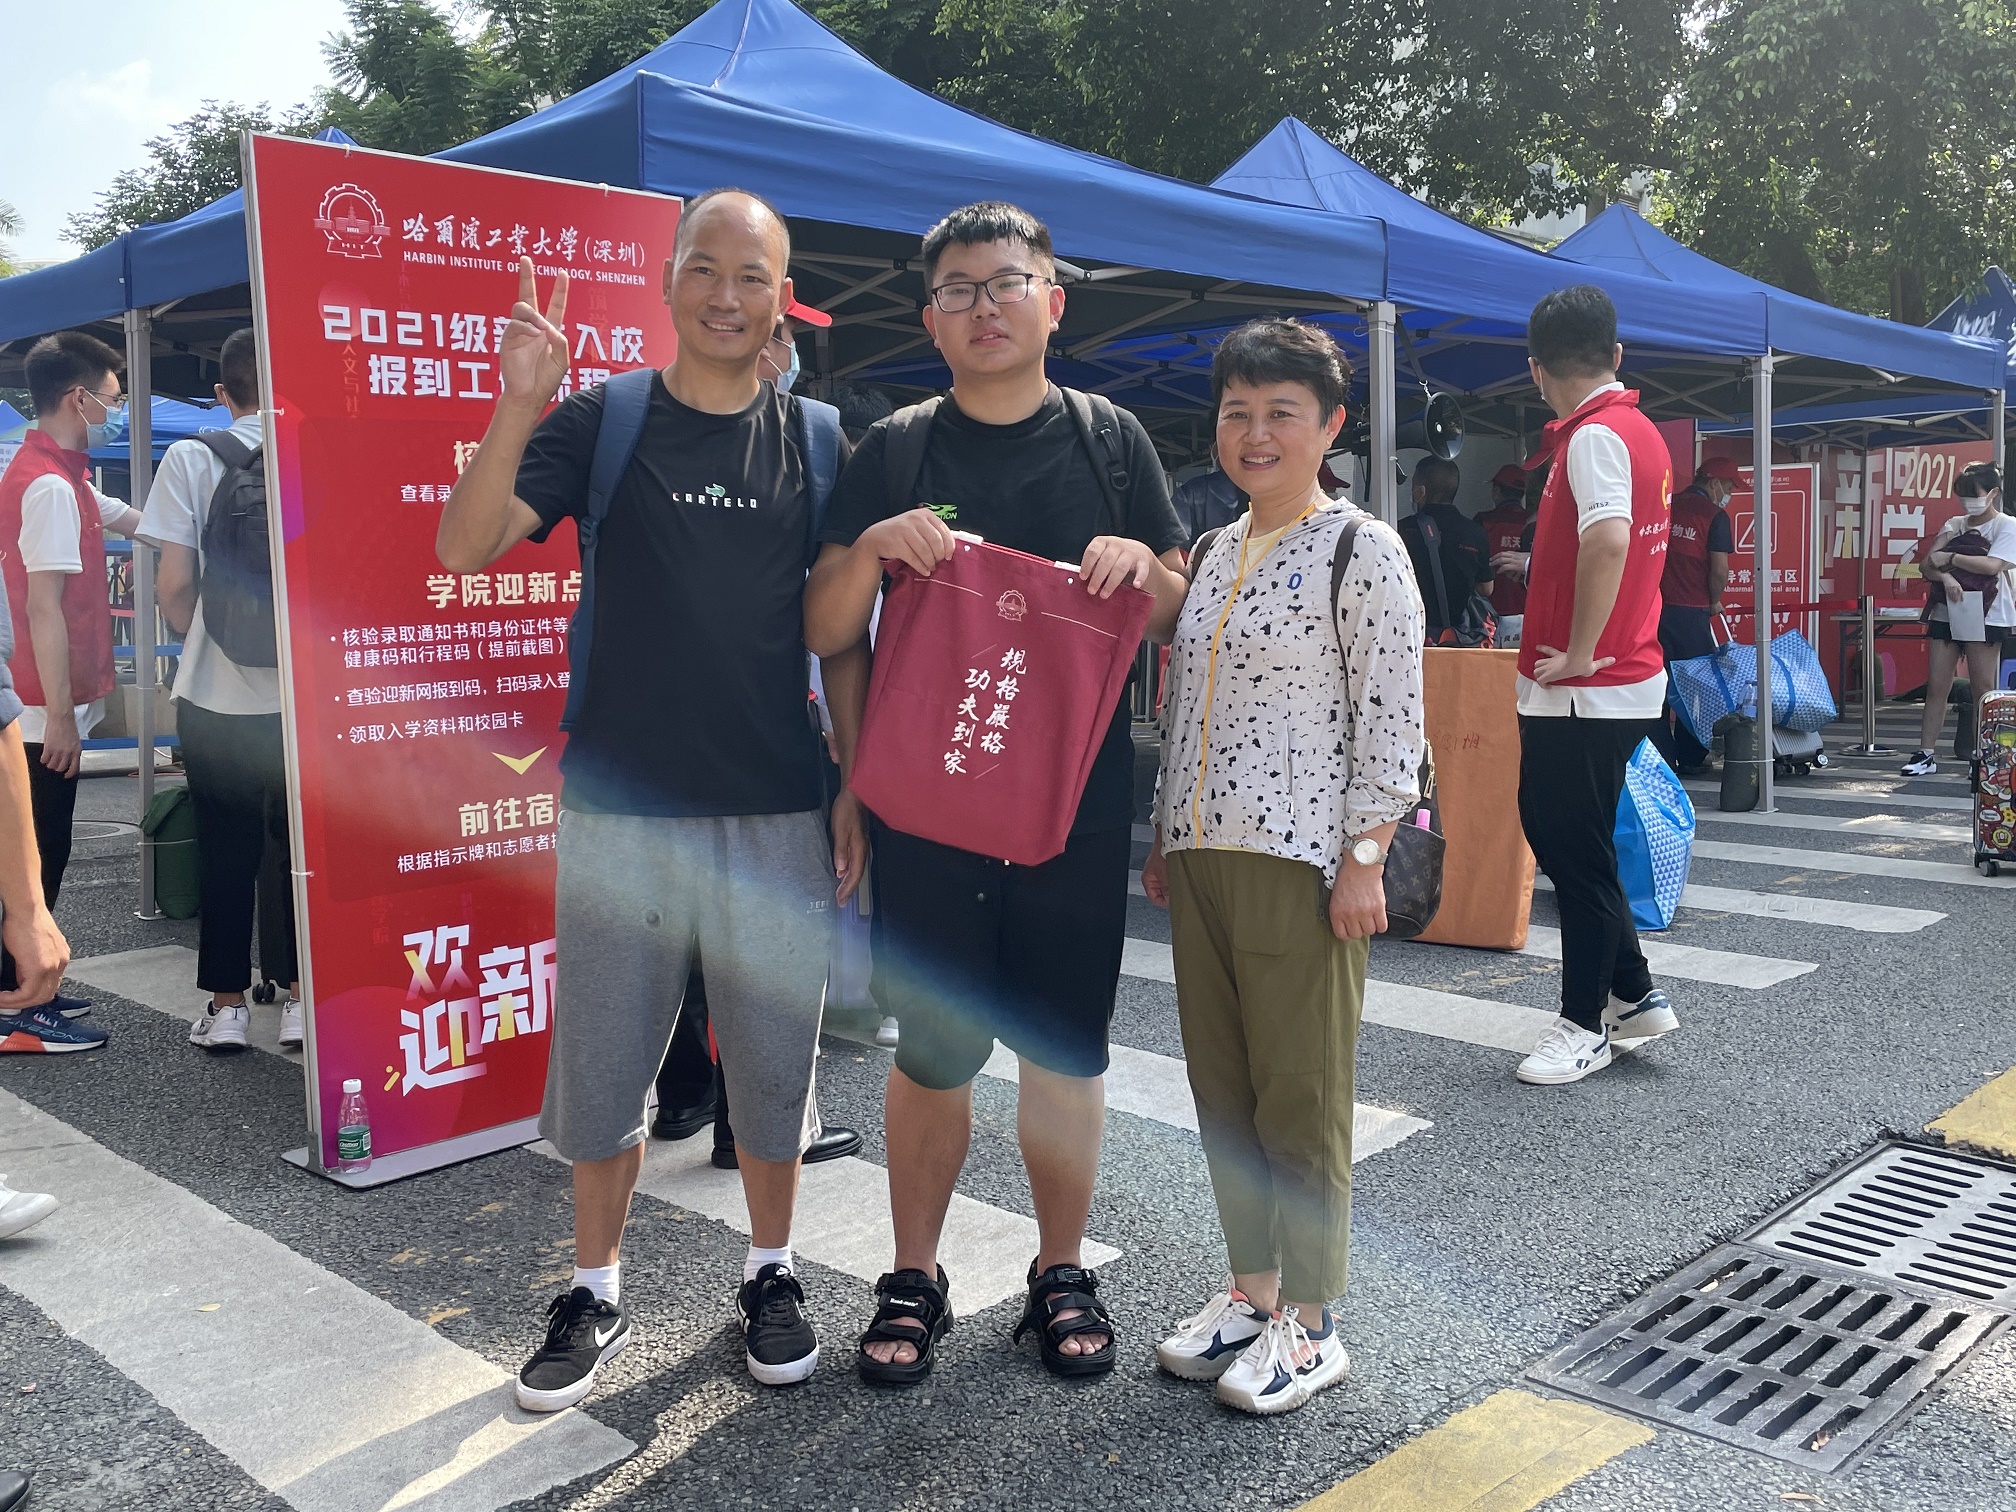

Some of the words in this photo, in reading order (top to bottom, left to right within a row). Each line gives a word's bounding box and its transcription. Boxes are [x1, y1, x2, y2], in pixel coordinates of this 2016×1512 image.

[403, 250, 445, 266] HARBIN
[450, 255, 502, 272] INSTITUTE
[507, 262, 520, 273] OF
[596, 270, 646, 286] SHENZHEN
[322, 304, 644, 364] 2021级入校
[1901, 451, 1956, 499] 2021
[672, 492, 757, 509] CARTELO
[1588, 501, 1609, 512] HITSZ
[1669, 524, 1696, 540] 物业
[425, 570, 583, 609] 学院迎新点
[1727, 569, 1798, 584] 异常置区
[342, 617, 568, 646] 核验录取通知书和身份证件等
[343, 636, 566, 669] 健康码和行程码（提前截图）
[348, 710, 524, 744] 领取入学资料和校园卡
[943, 668, 991, 776] 功夫到家
